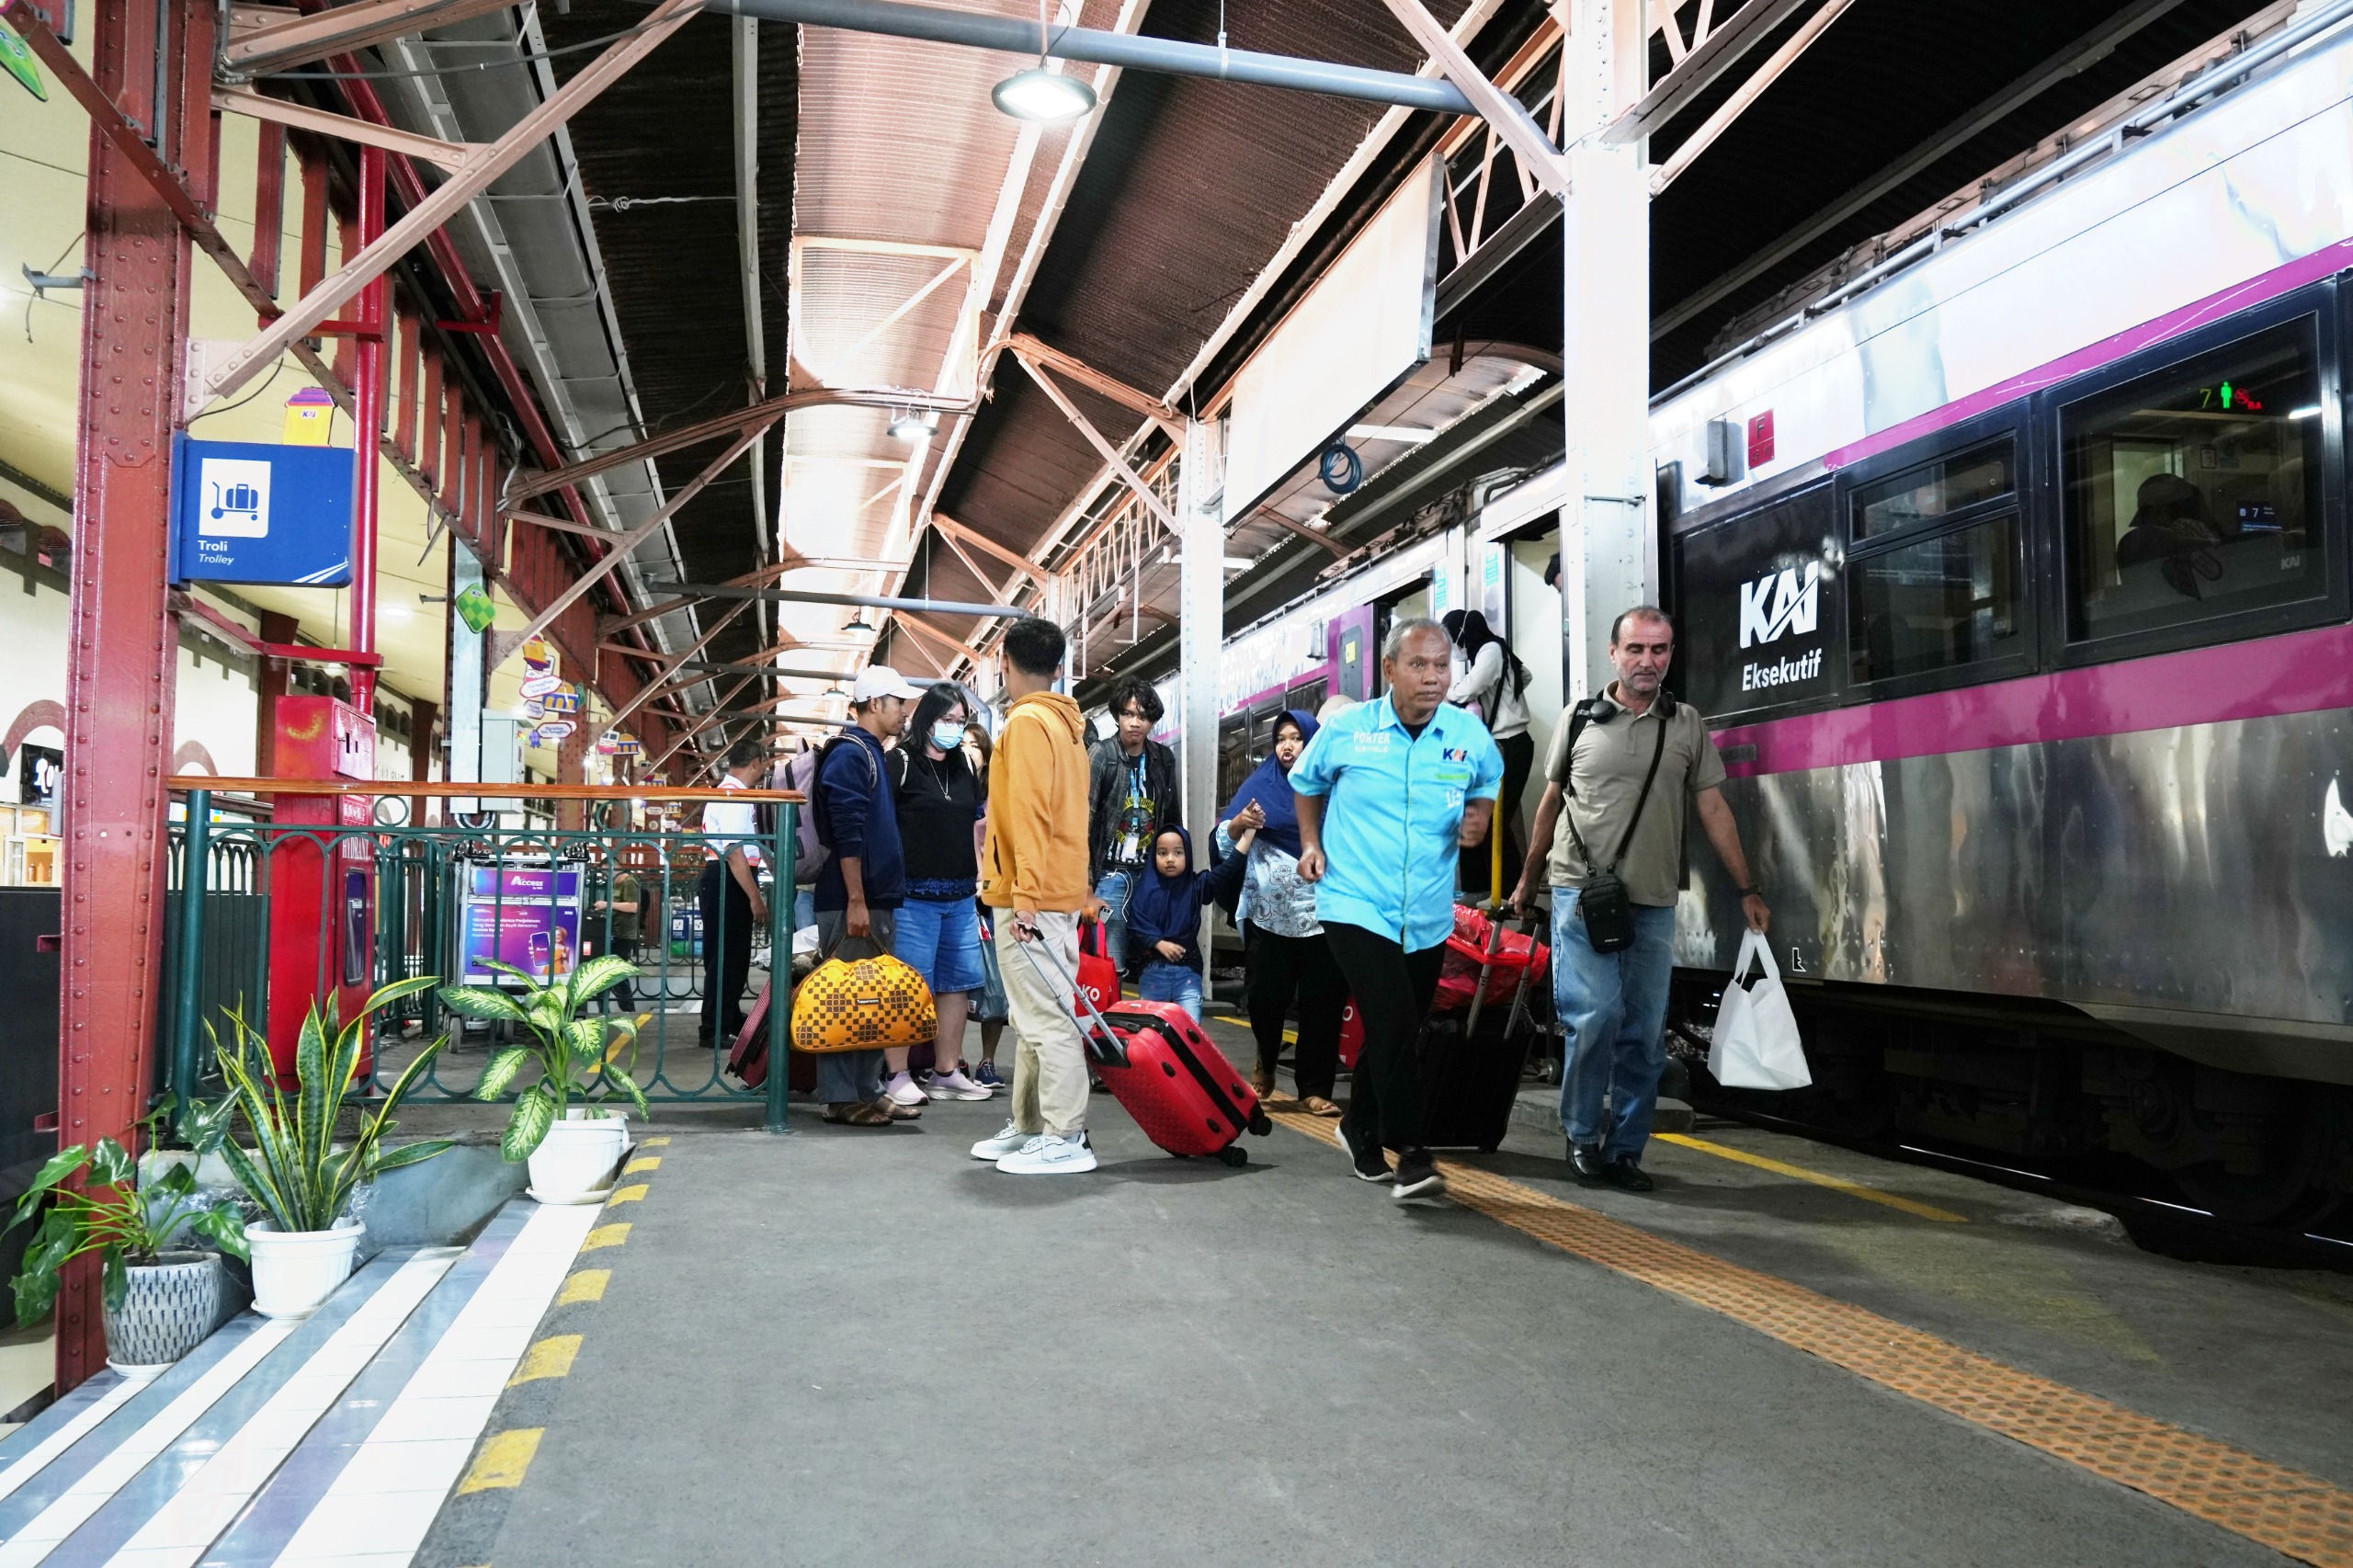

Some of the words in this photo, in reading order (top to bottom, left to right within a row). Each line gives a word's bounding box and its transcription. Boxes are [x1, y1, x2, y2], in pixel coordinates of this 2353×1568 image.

[2200, 388, 2211, 408] 7
[1756, 415, 1766, 439] F
[2252, 507, 2258, 518] 7
[198, 540, 228, 551] Troli
[199, 553, 234, 566] Trolley
[1740, 561, 1819, 649] KAI
[1742, 648, 1823, 692] Eksekutif
[1353, 732, 1391, 744] PORTER
[1442, 747, 1468, 762] KAI
[511, 875, 543, 887] Access
